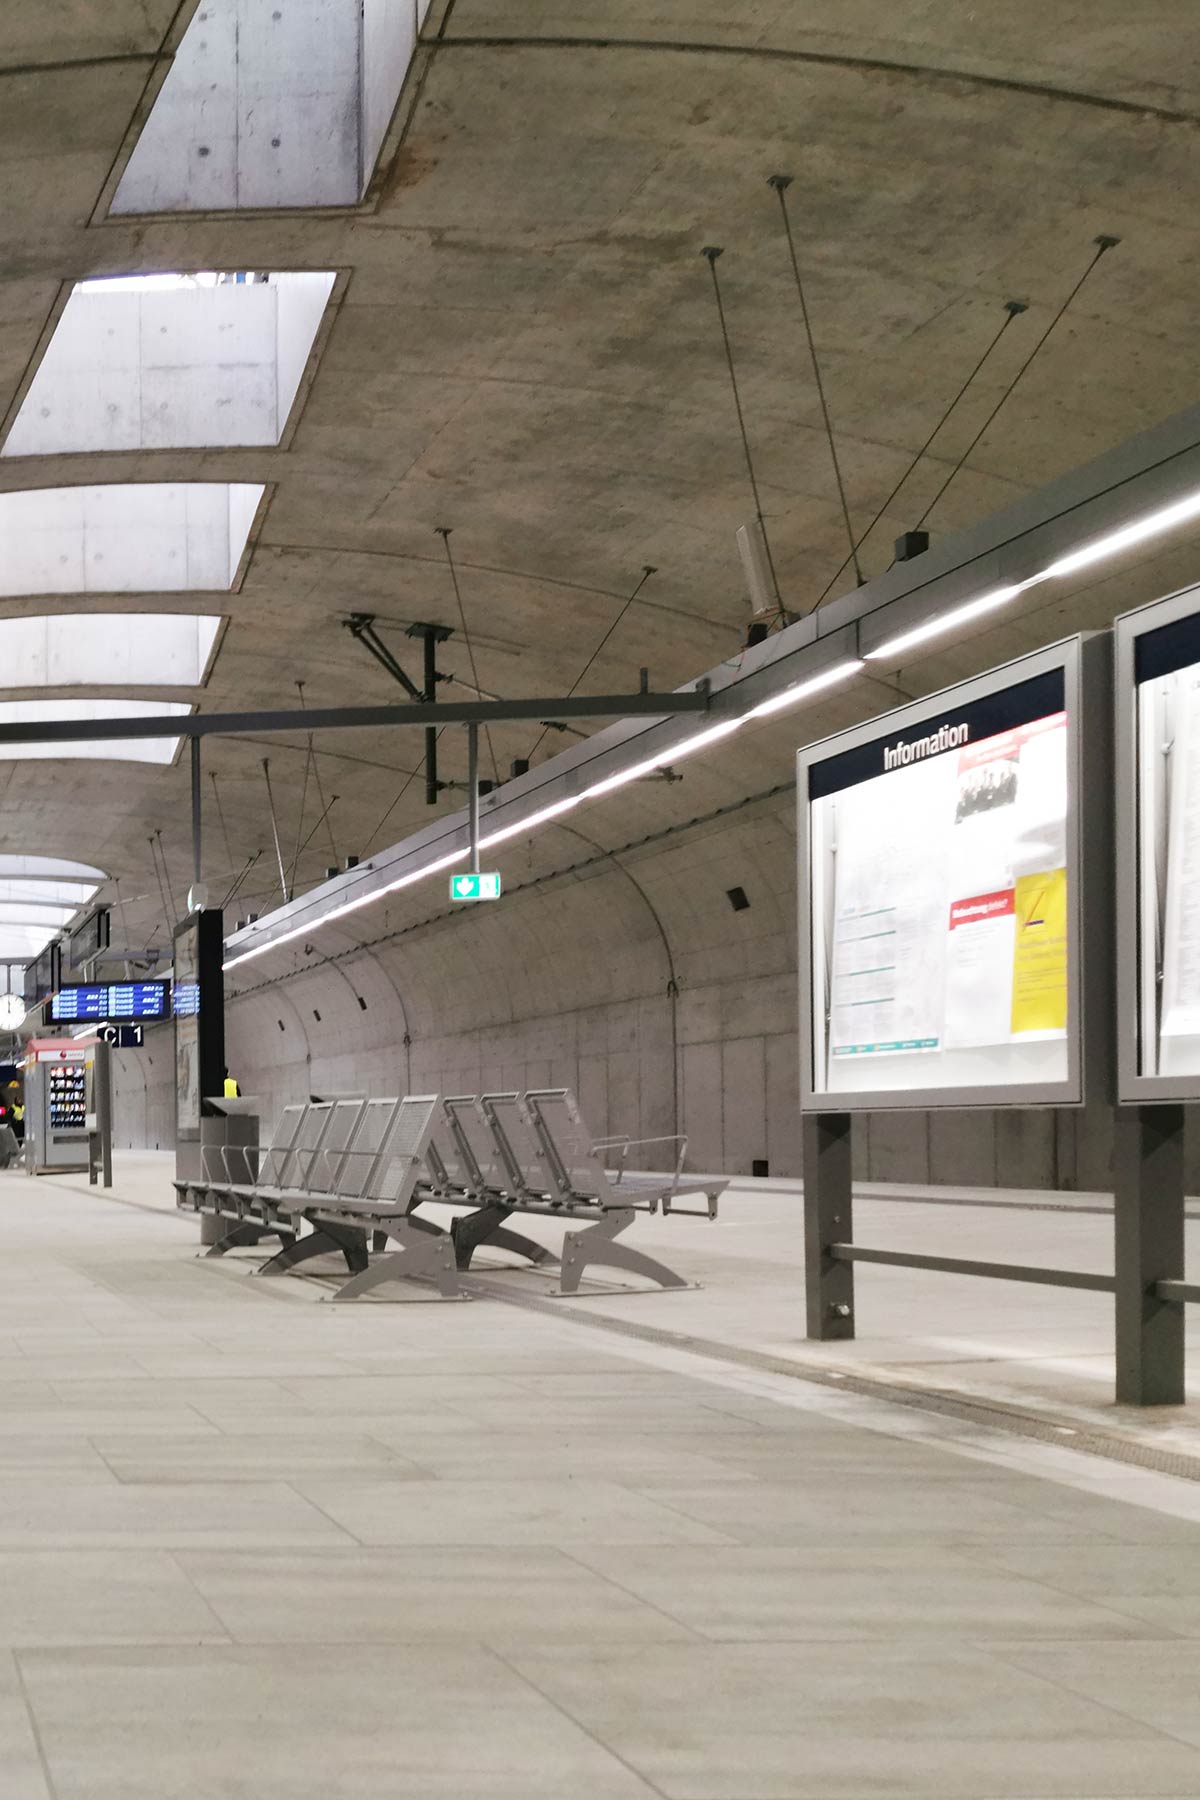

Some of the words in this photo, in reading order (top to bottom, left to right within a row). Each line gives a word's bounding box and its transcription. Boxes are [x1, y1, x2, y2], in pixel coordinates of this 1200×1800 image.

[883, 722, 969, 771] Information
[104, 1027, 116, 1043] C
[133, 1027, 142, 1044] 1
